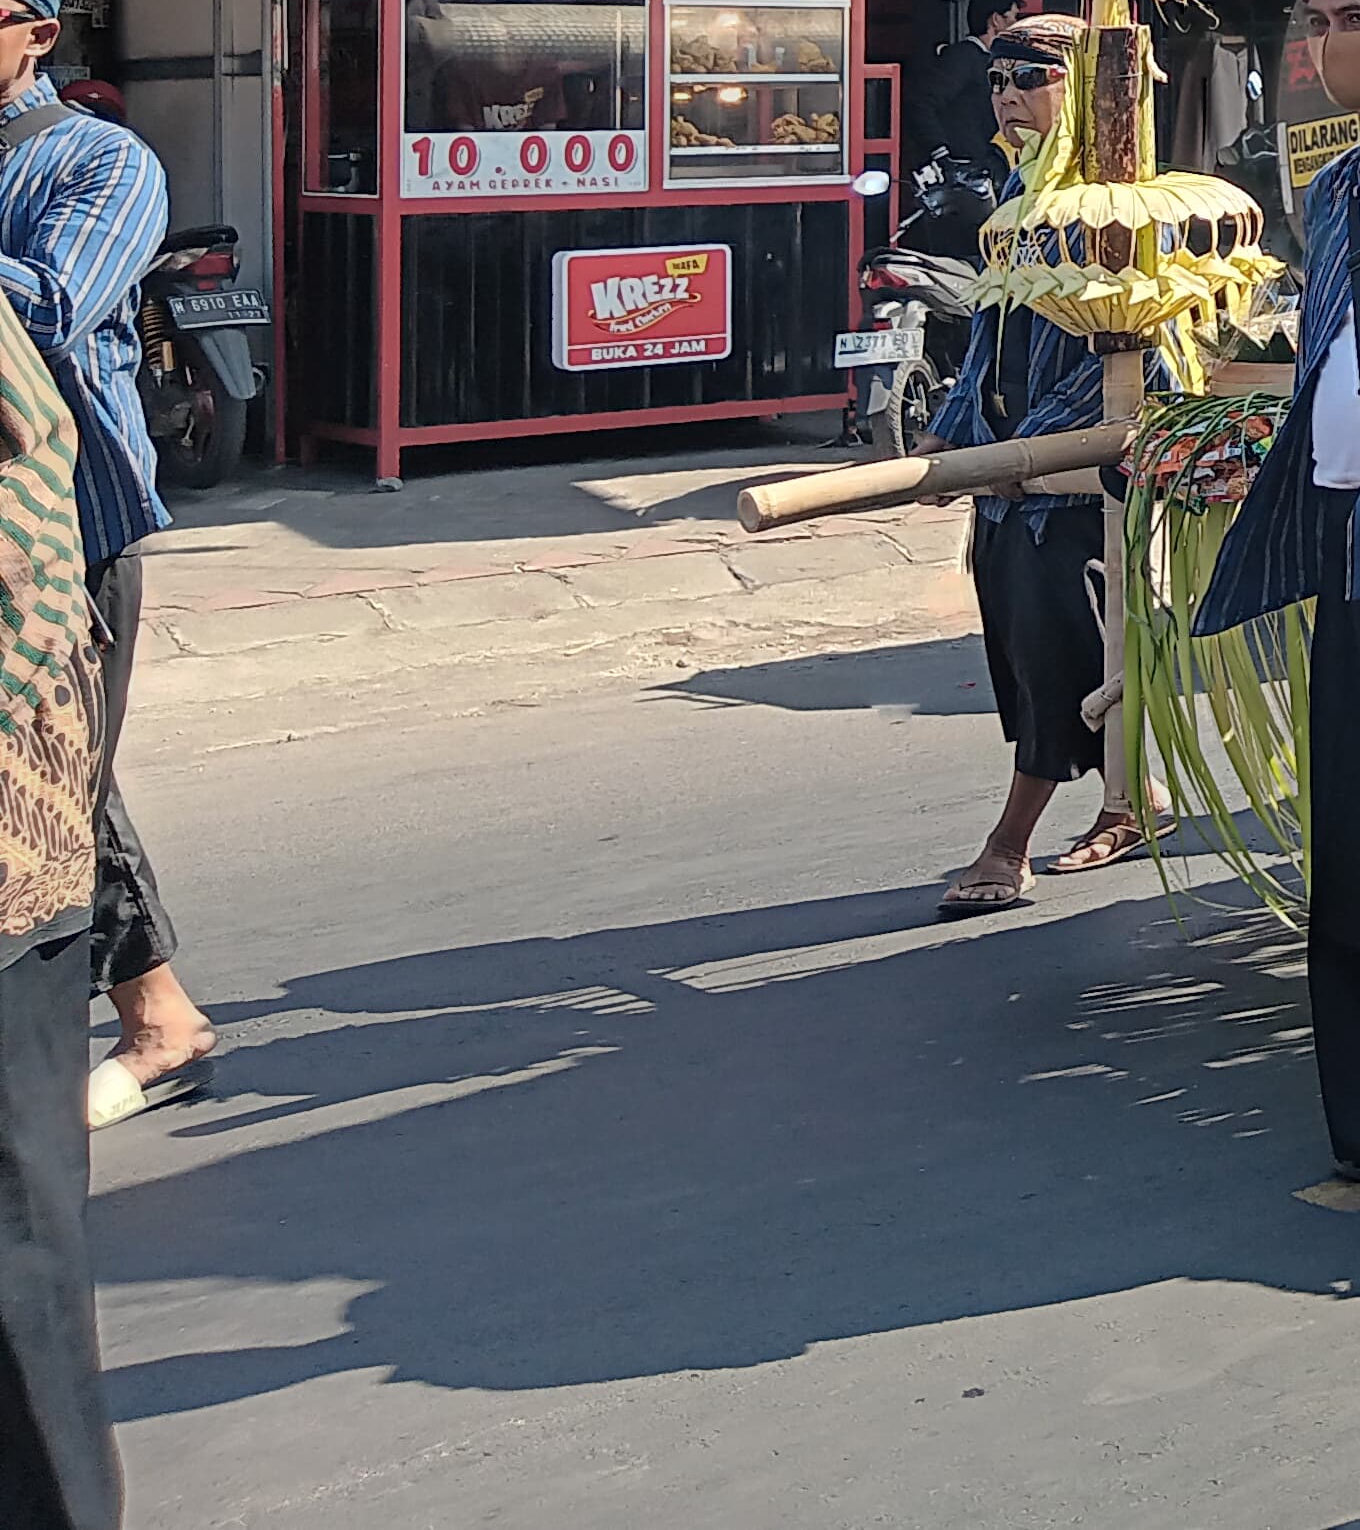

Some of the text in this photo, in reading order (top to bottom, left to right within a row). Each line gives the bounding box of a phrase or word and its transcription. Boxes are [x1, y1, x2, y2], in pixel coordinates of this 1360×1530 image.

[1290, 118, 1359, 155] DILARANG
[411, 133, 637, 178] 10.000
[432, 179, 481, 191] AYAM
[576, 176, 620, 188] NASI
[190, 297, 226, 312] 6910
[231, 293, 259, 308] EAA
[590, 273, 690, 320] KREZZ
[591, 339, 706, 361] BUKA 24 JAM
